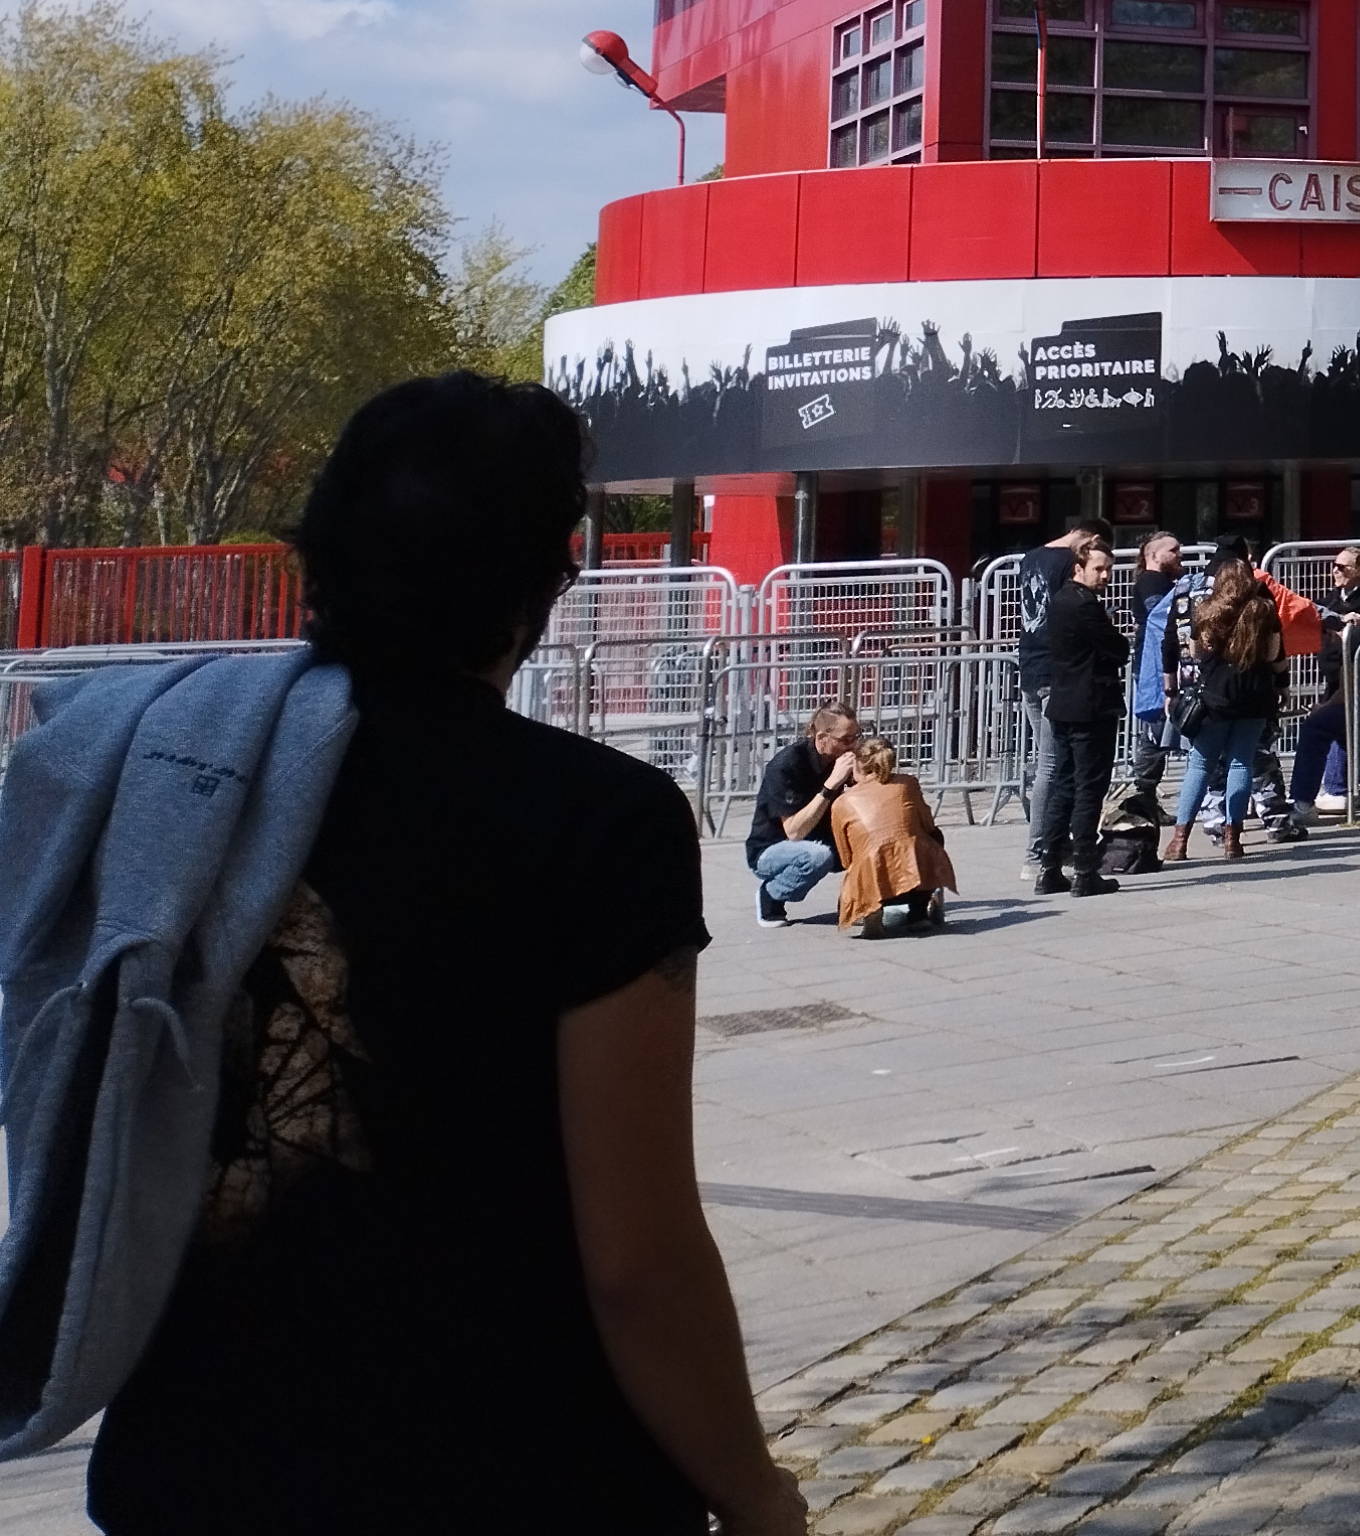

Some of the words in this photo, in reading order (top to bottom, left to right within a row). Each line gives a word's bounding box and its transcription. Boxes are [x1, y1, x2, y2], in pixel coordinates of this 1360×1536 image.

[767, 346, 871, 371] BILLETTERIE
[1035, 341, 1096, 362] ACCÈS
[767, 366, 872, 391] INVITATIONS
[1035, 359, 1156, 381] PRIORITAIRE
[1026, 501, 1034, 518] 1
[1140, 500, 1149, 516] 2
[1250, 498, 1259, 513] 3
